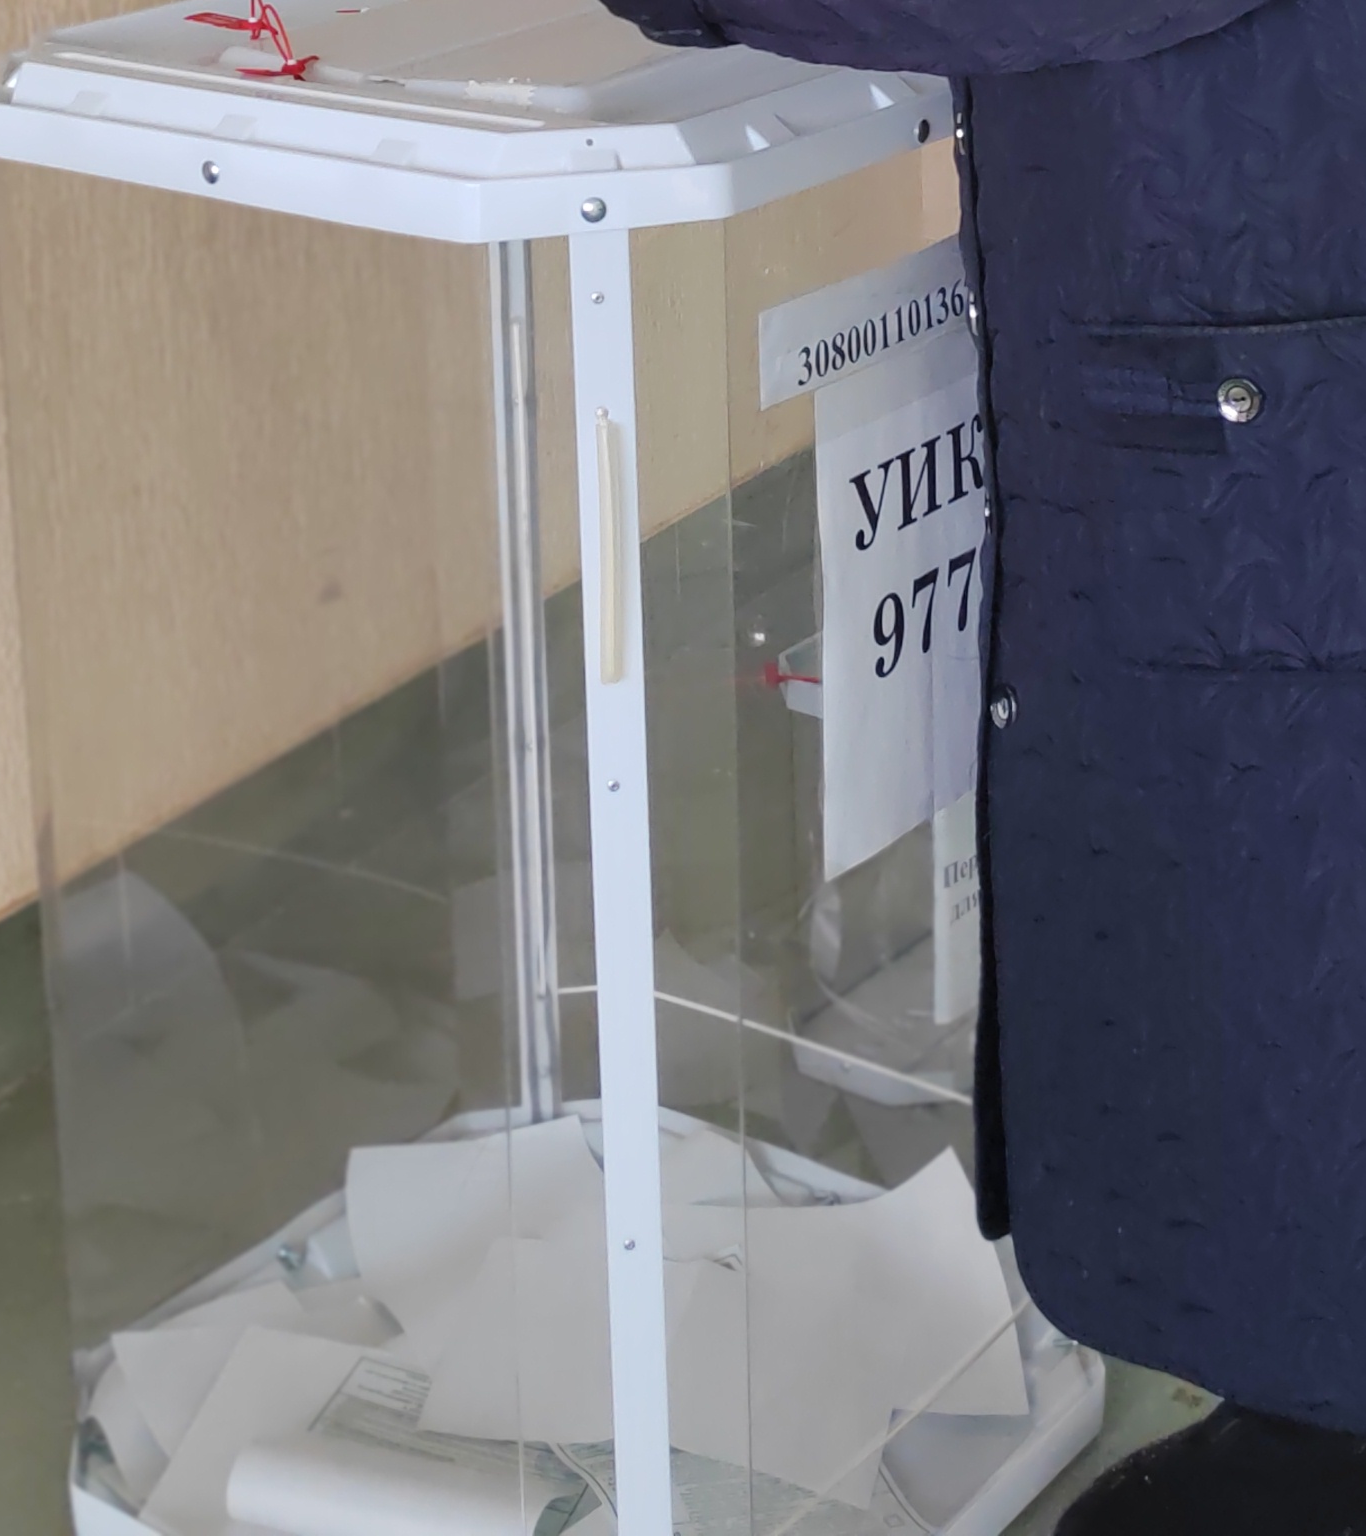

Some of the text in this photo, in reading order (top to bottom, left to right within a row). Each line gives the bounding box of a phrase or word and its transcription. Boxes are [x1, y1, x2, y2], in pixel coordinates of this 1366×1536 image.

[798, 279, 965, 386] 30800110136
[849, 413, 984, 551] УИК
[873, 547, 977, 678] 977
